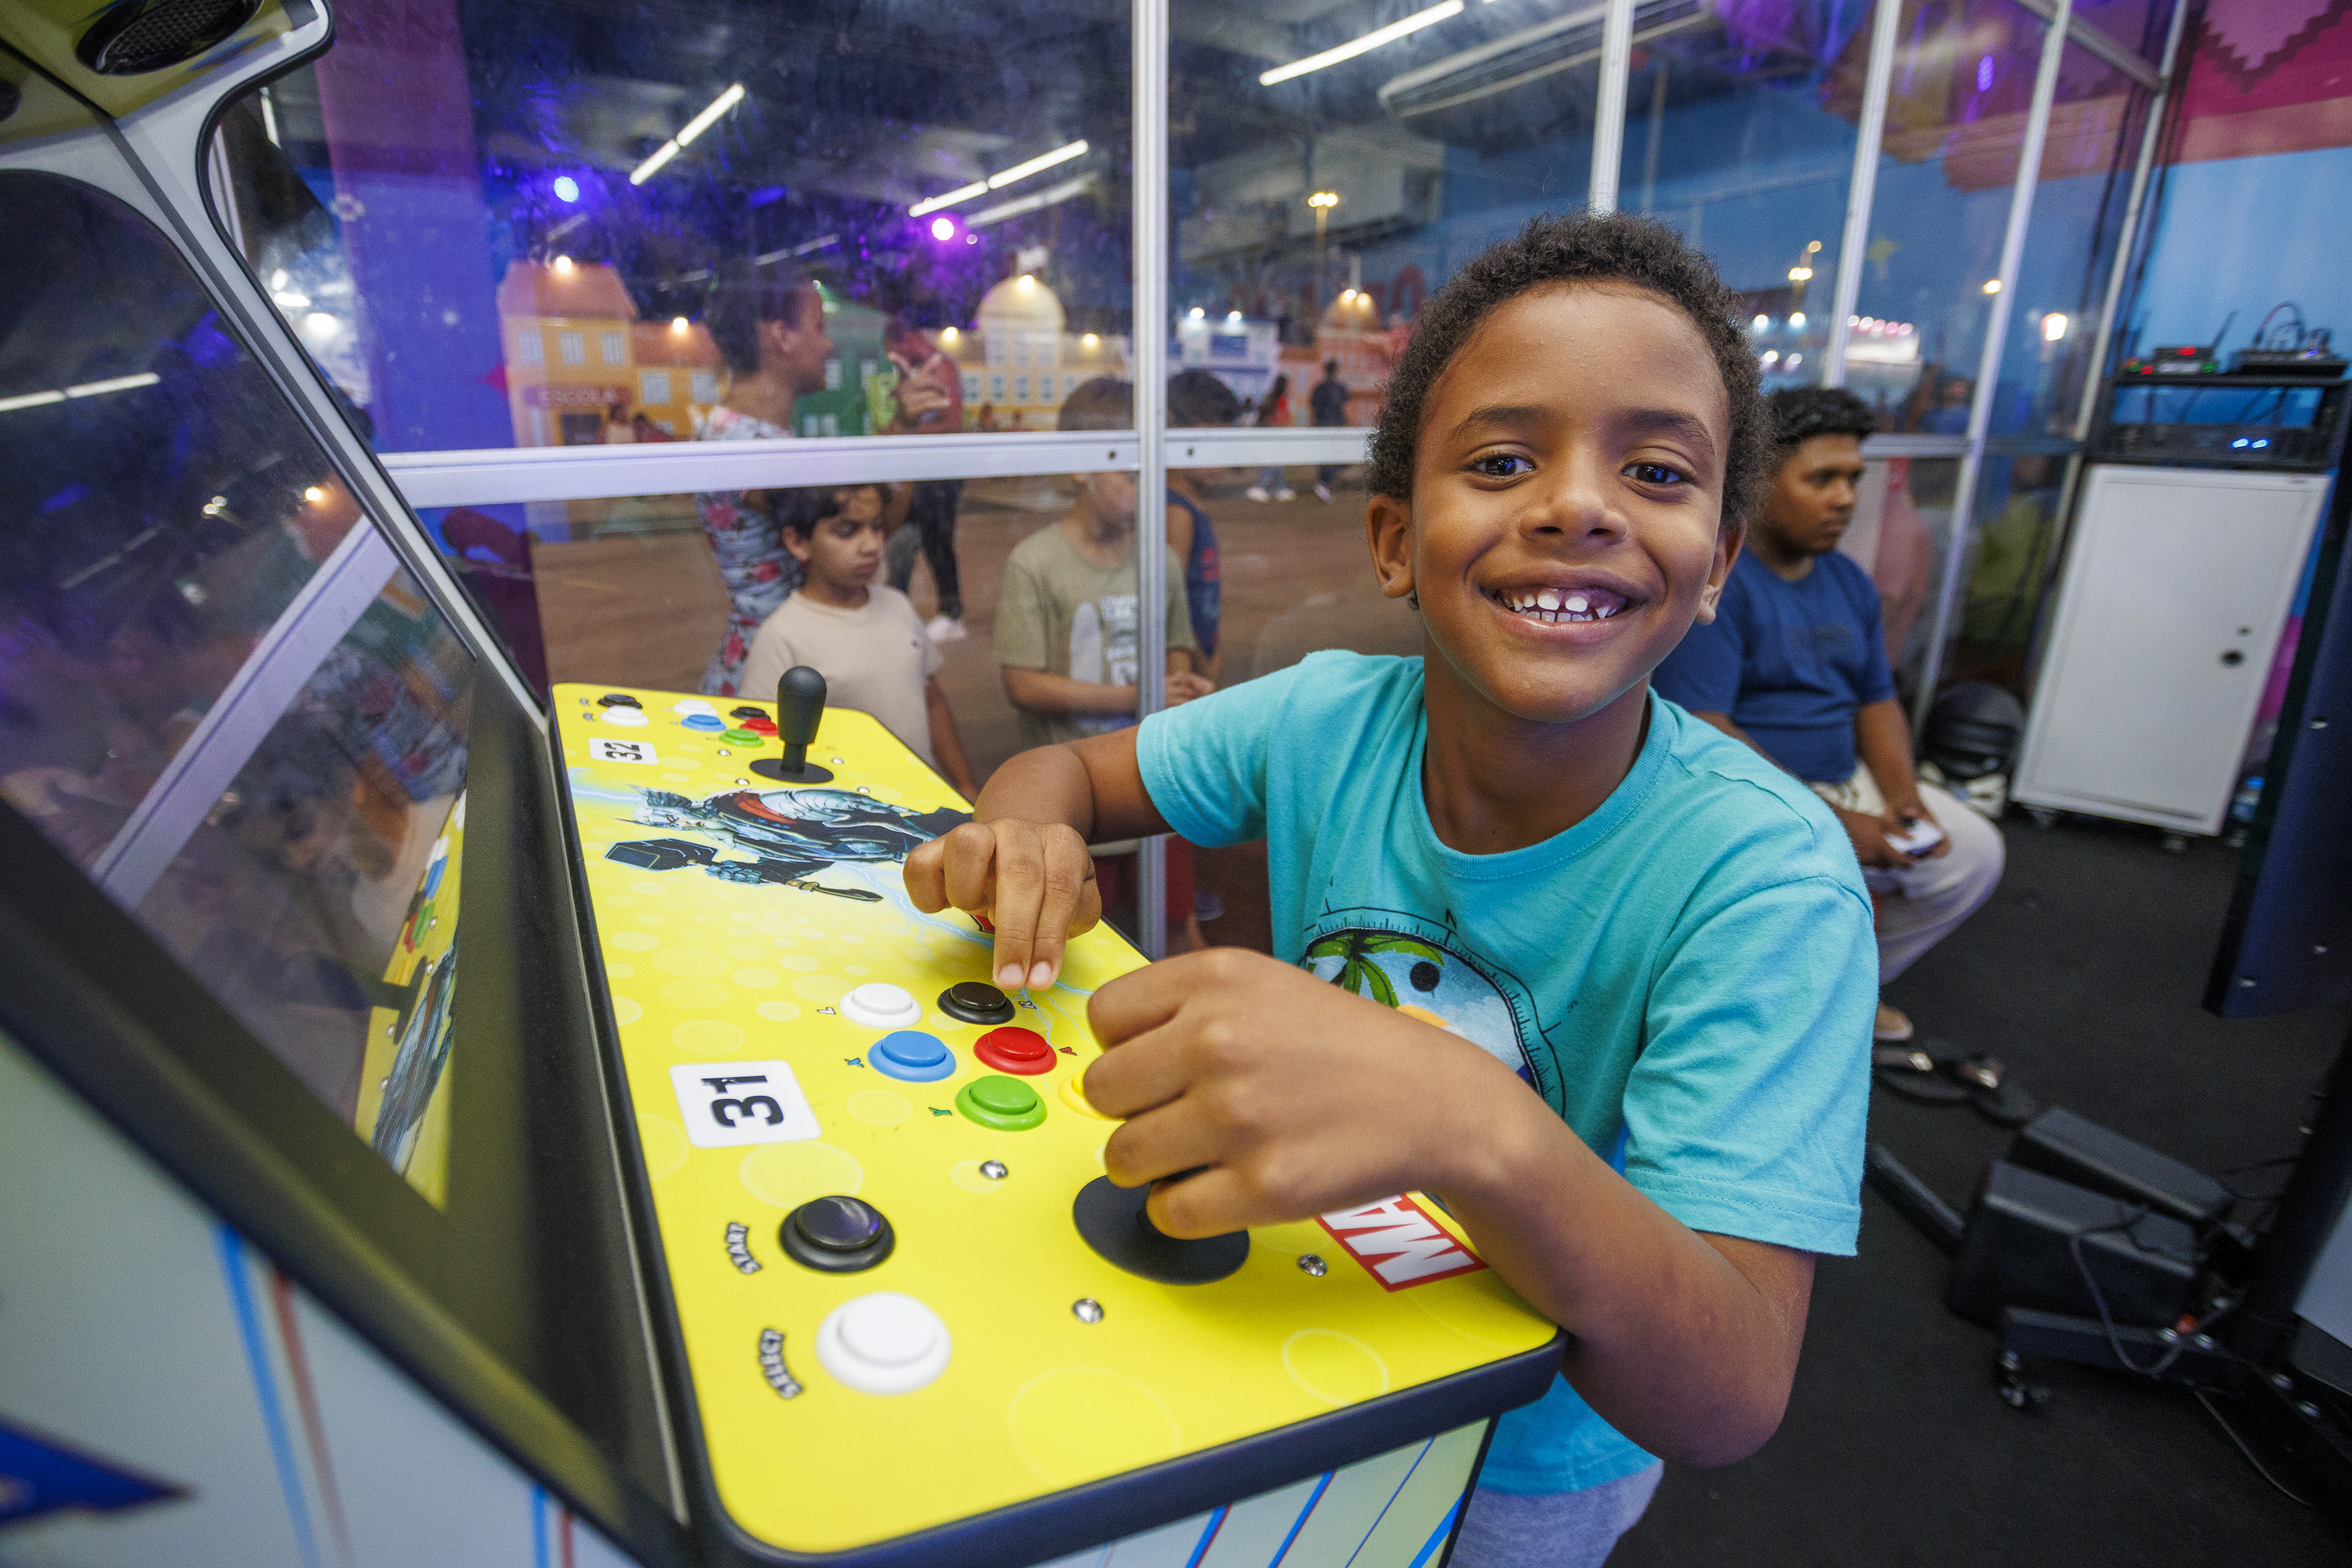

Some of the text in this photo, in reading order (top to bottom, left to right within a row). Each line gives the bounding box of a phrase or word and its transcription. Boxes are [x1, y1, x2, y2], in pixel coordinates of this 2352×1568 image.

[604, 742, 642, 760] 32
[1019, 1001, 1037, 1009] R
[816, 1007, 836, 1015] L
[1059, 1046, 1077, 1056] A
[844, 1057, 864, 1068] X
[701, 1075, 784, 1128] 31
[928, 1106, 952, 1117] Y
[725, 1222, 762, 1274] START
[759, 1329, 804, 1399] SELECT
